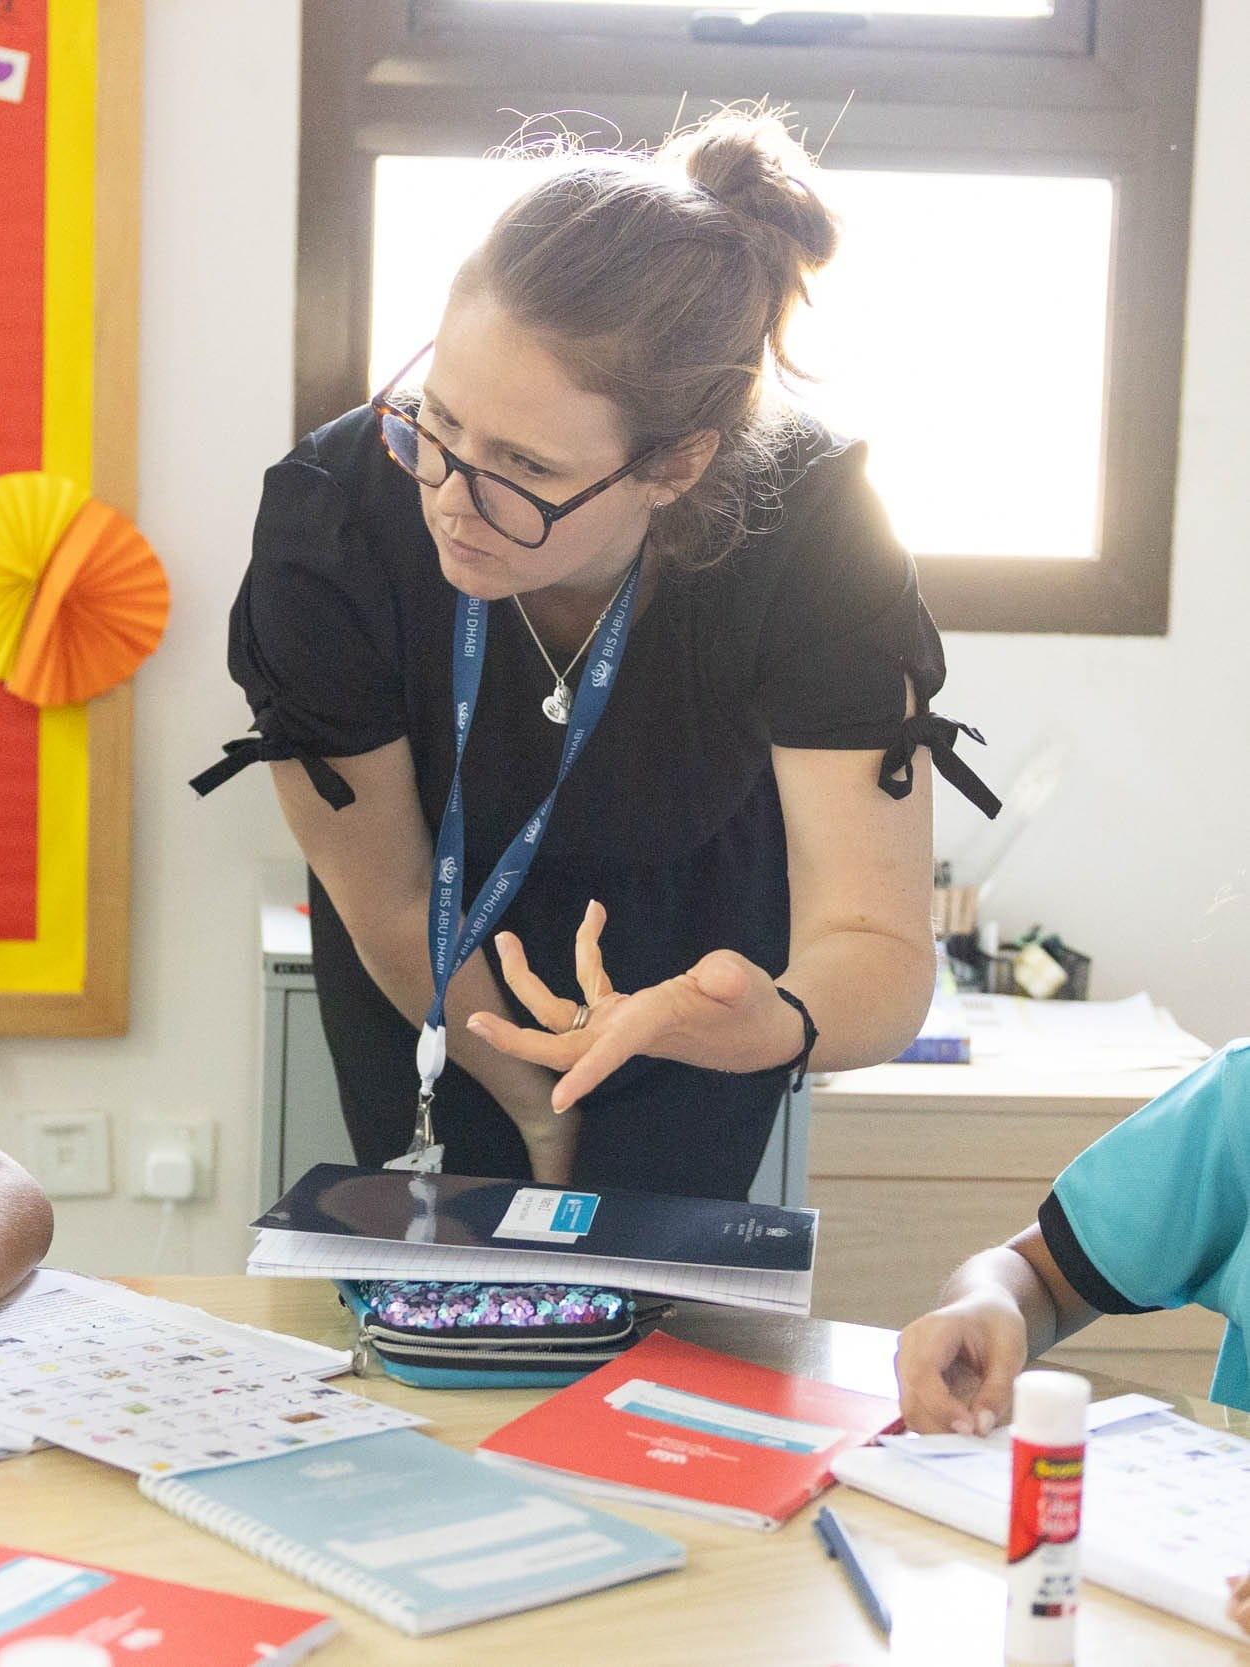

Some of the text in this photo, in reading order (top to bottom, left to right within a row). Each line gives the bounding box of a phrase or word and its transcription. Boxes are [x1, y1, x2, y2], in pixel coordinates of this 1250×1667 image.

[463, 618, 479, 658] DHABI
[601, 636, 618, 659] BIS
[610, 609, 627, 637] ABU
[436, 887, 453, 975] BIS ABU DHABI
[460, 877, 511, 956] BIS ABU DHABI
